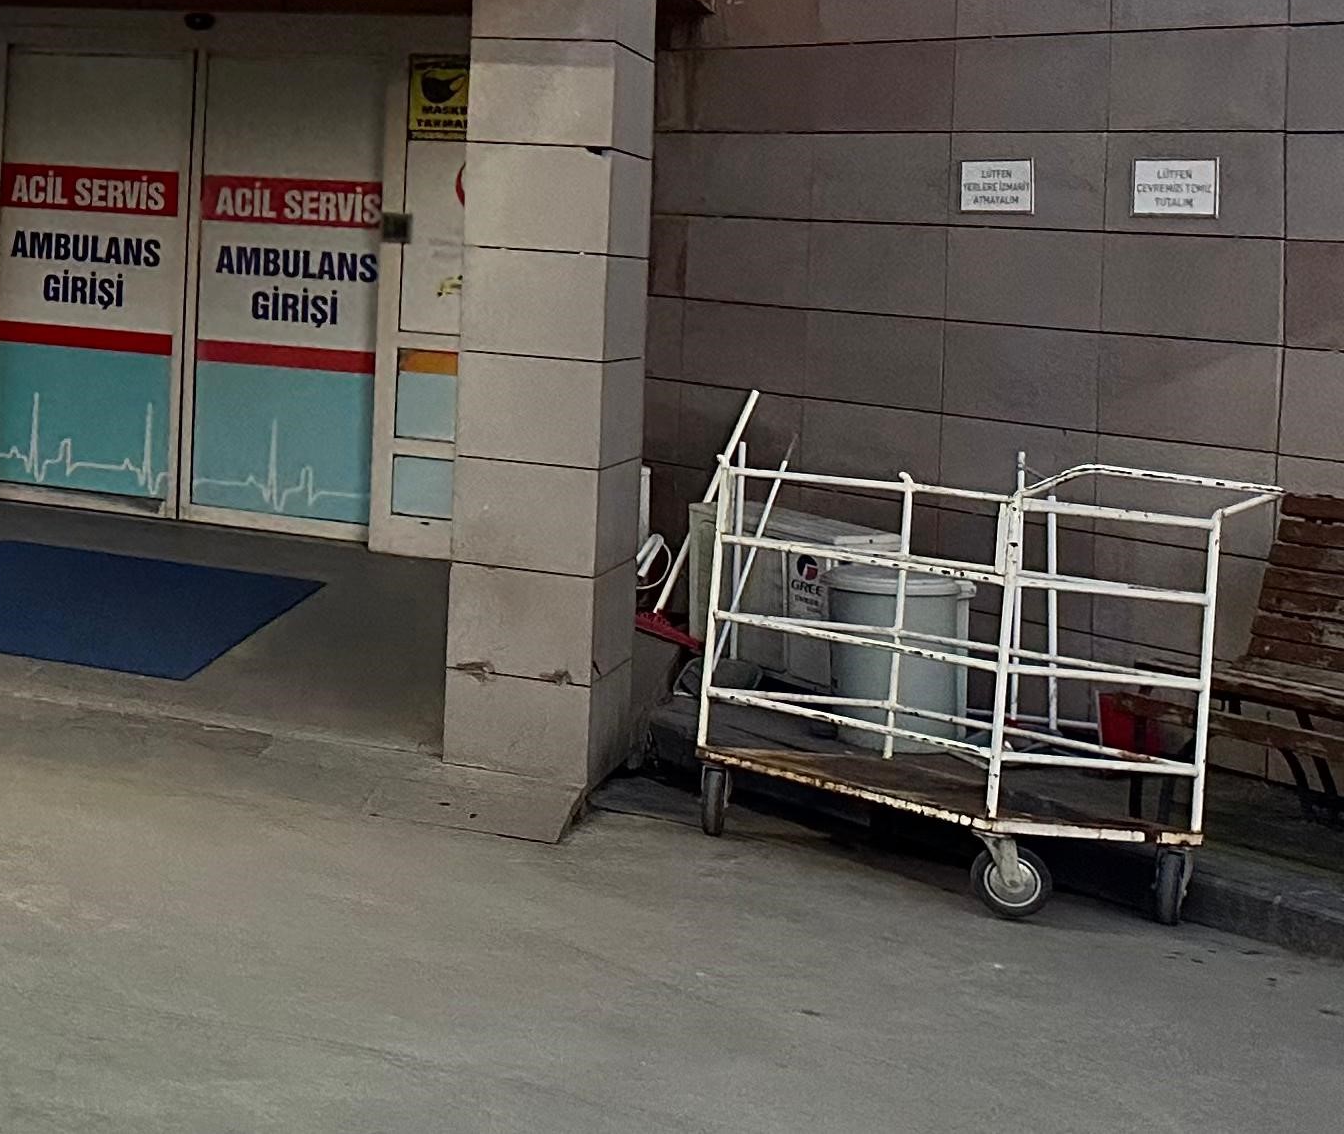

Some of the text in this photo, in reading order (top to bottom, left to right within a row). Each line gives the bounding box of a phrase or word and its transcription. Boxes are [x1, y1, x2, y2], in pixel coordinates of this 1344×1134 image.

[12, 170, 166, 211] ACİL SERVİS
[215, 181, 382, 226] ACİL SERVİS
[10, 230, 161, 267] AMBULANS
[215, 245, 379, 283] AMBULANS
[43, 269, 124, 310] GİRİŞİ
[251, 285, 338, 328] GİRİŞİ
